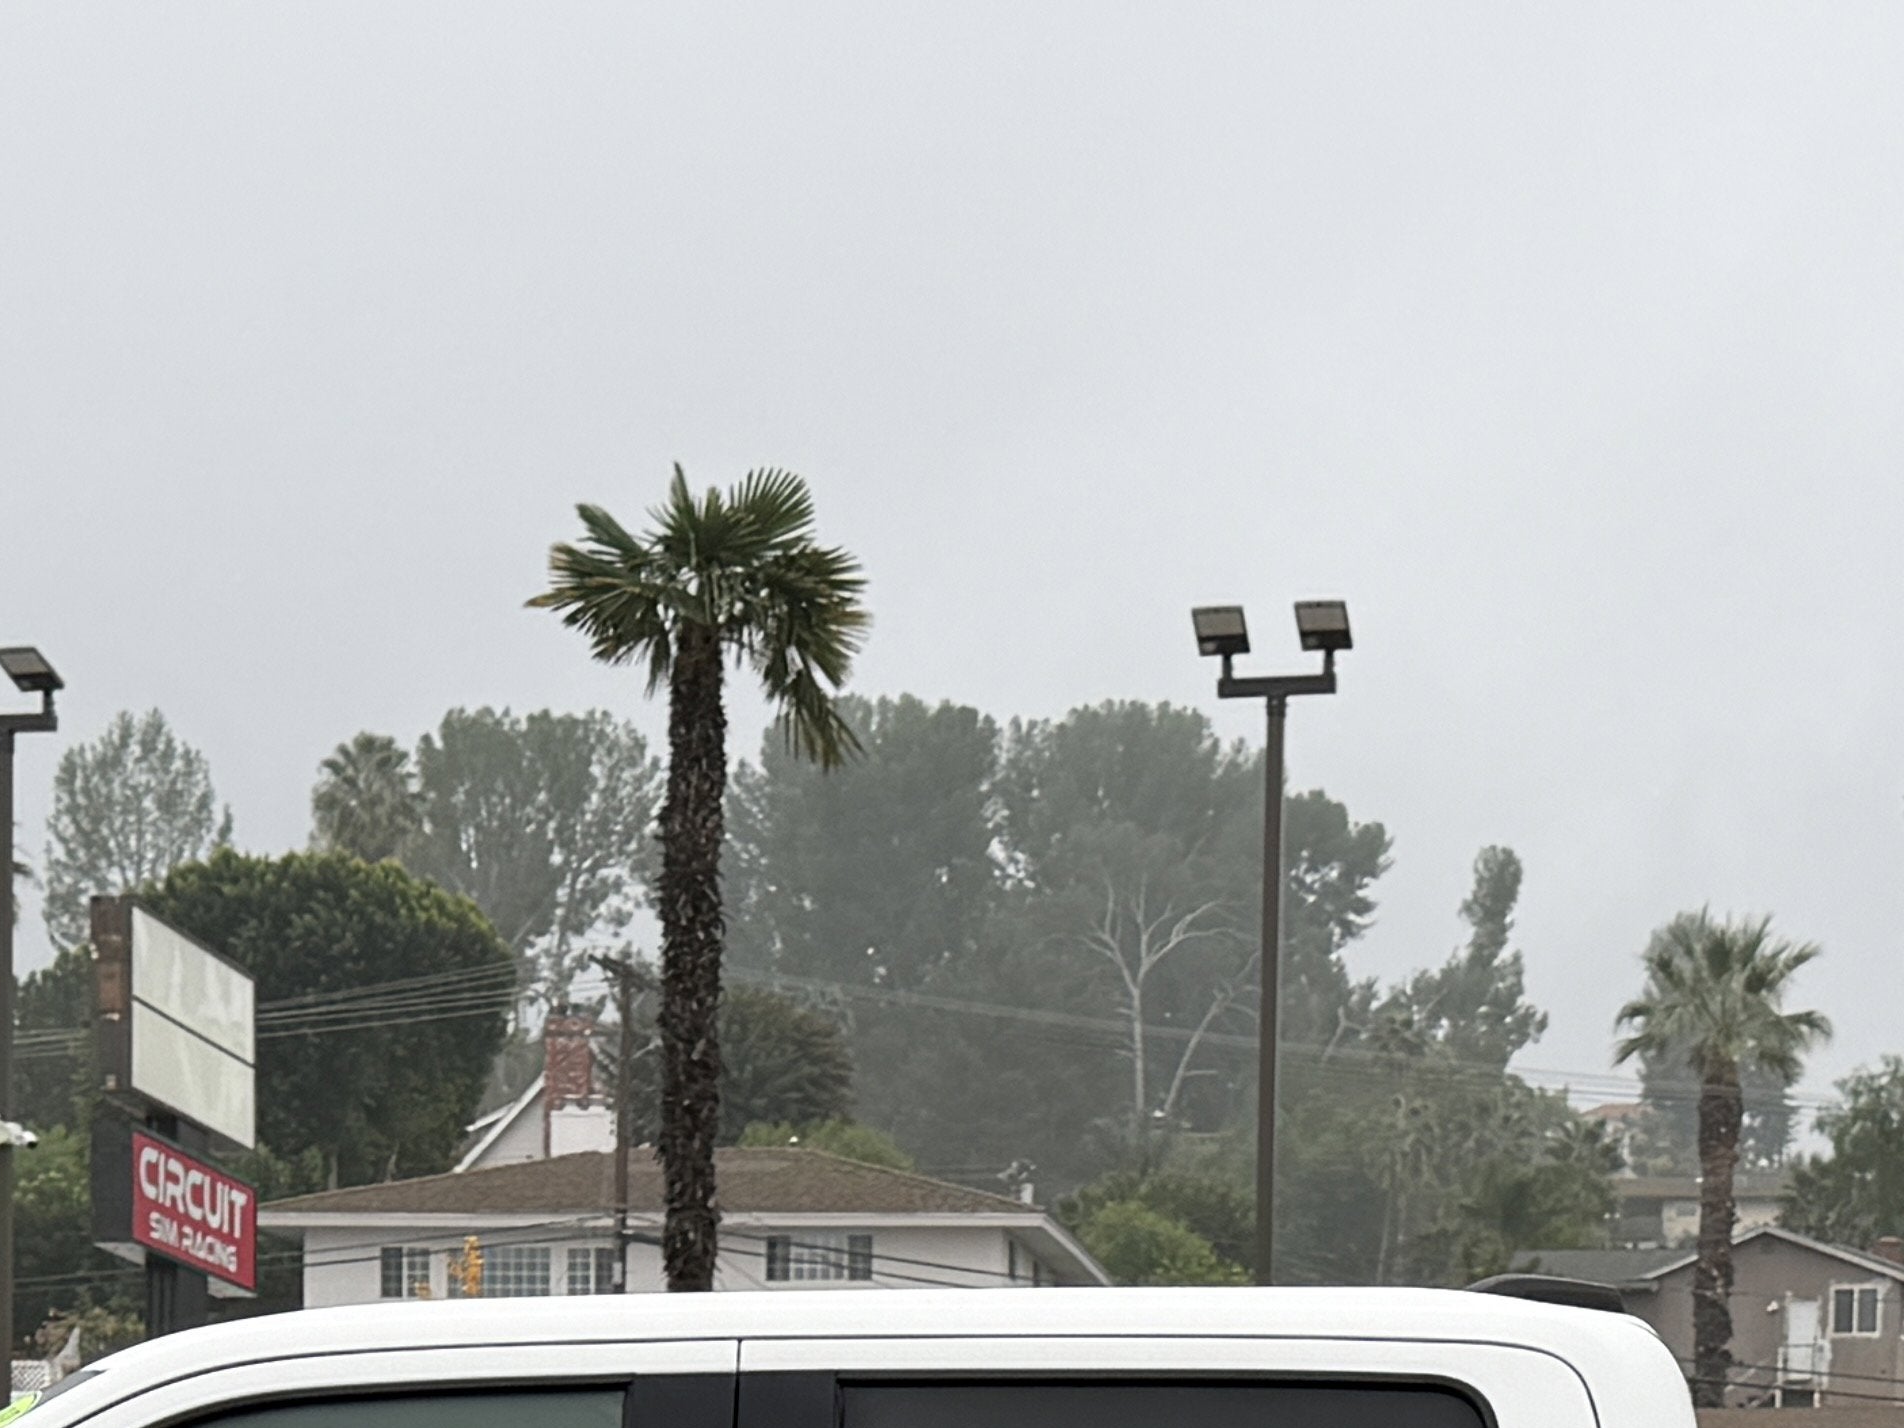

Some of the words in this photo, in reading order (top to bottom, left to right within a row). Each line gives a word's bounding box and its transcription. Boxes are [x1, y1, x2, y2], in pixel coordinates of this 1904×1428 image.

[140, 1146, 248, 1238] CIRCUIT
[149, 1211, 179, 1247] SIM
[181, 1225, 237, 1273] RACING
